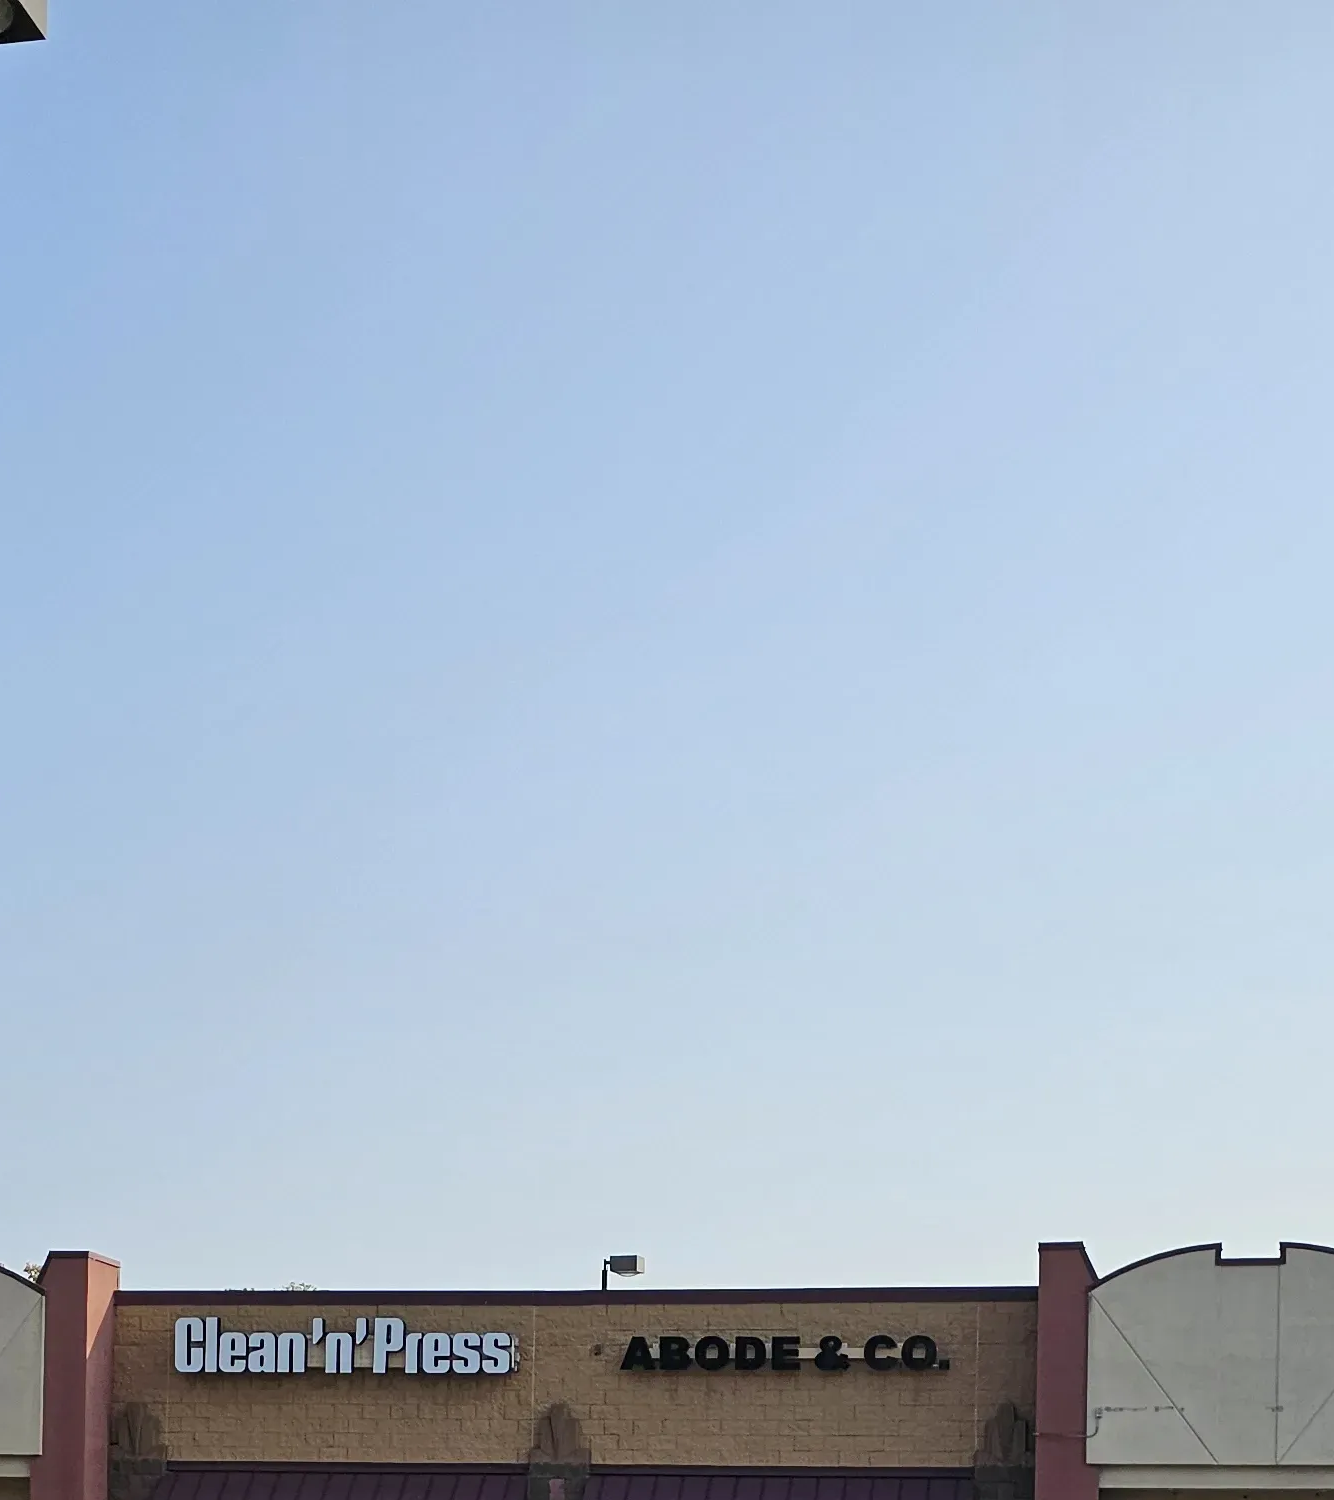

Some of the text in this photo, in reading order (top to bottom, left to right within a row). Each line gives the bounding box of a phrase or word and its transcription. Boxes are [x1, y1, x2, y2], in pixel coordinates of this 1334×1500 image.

[619, 1335, 951, 1371] ABODE & CO.
